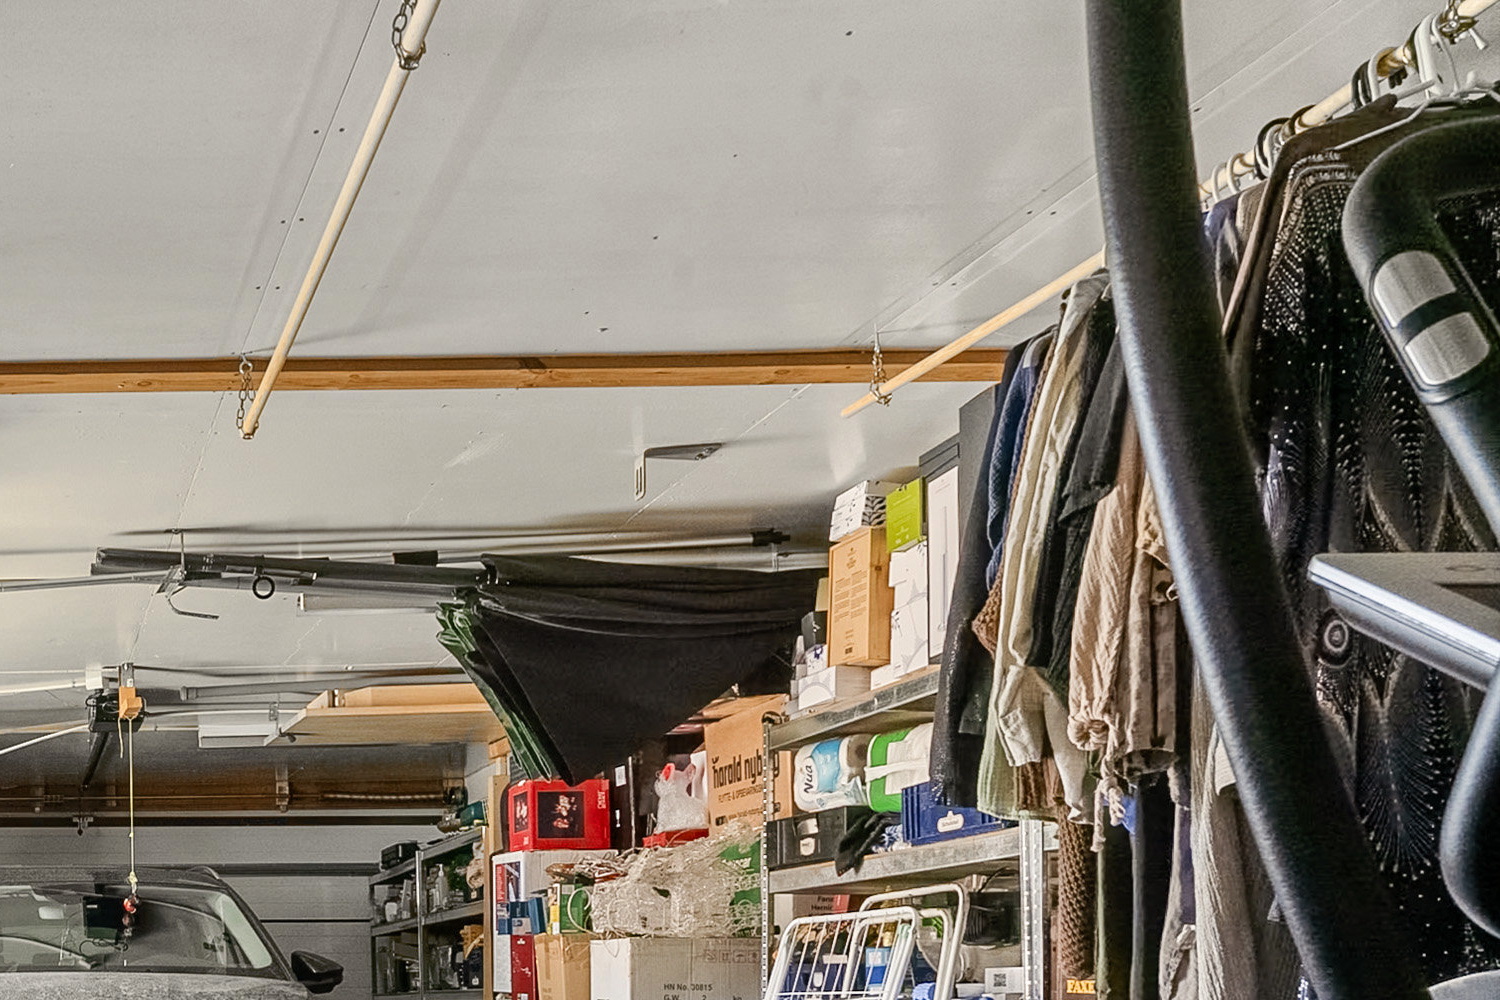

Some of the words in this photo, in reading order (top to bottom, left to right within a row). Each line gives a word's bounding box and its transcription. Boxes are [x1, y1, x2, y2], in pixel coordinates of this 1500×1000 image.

[711, 754, 742, 789] harald
[744, 749, 780, 784] nybg
[803, 764, 813, 794] Nua
[663, 983, 675, 991] HN
